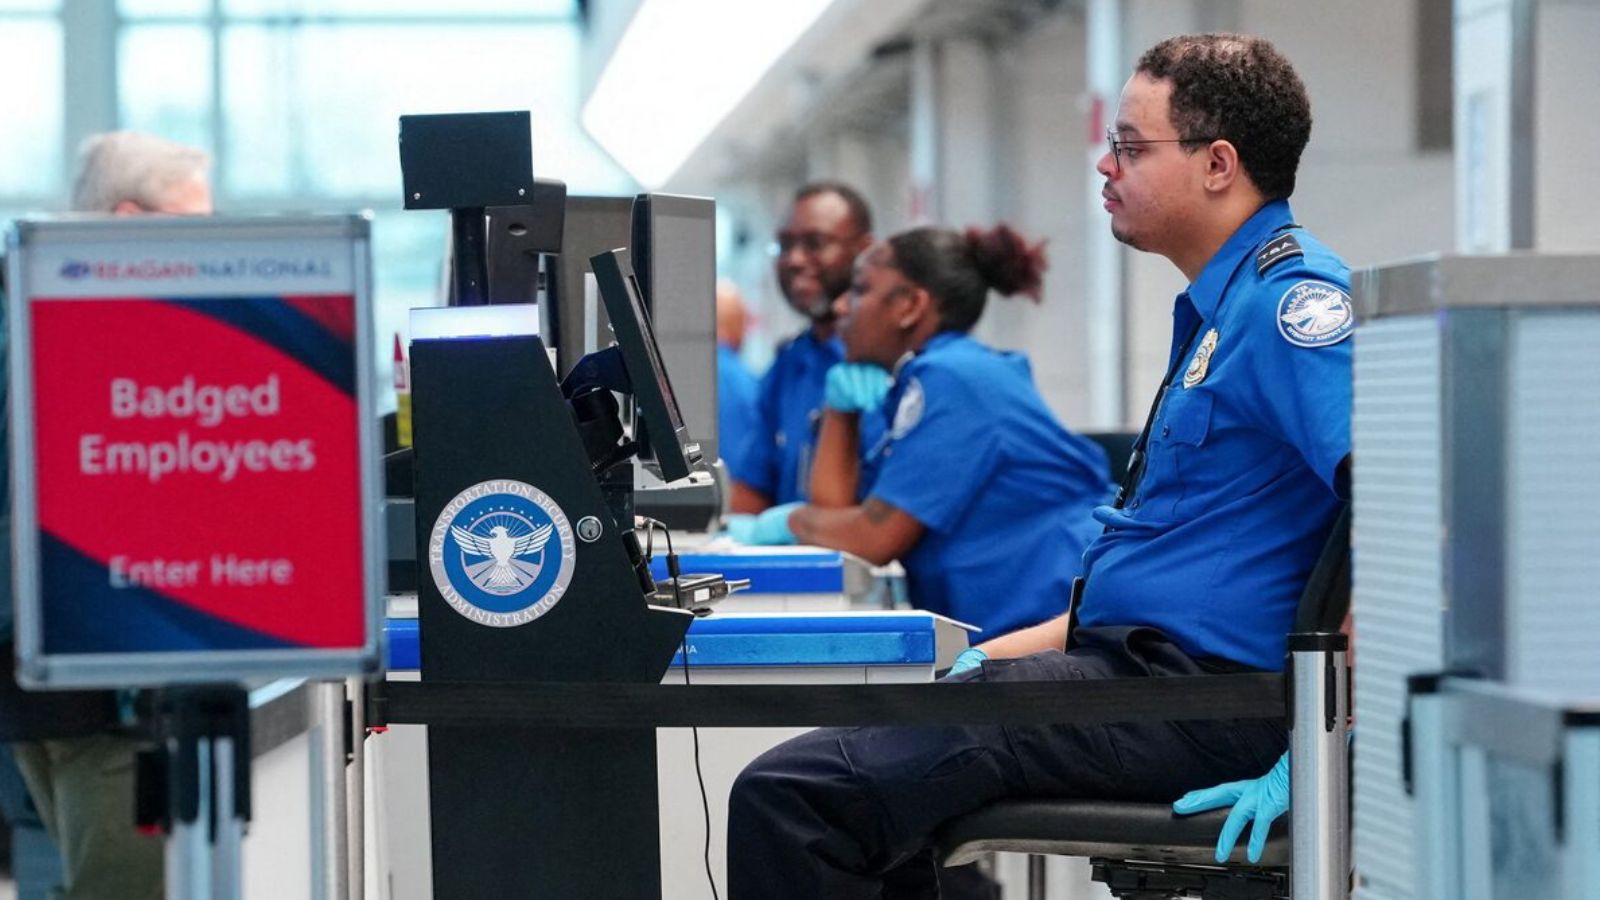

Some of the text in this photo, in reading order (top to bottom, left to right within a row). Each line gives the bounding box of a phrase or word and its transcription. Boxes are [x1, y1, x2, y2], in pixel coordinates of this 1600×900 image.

[110, 373, 281, 427] Badged
[79, 430, 316, 482] Employees
[430, 481, 574, 564] TRANSPORTATION SECURITY
[108, 553, 294, 589] Enter Here
[440, 584, 564, 626] ADMINISTRATION
